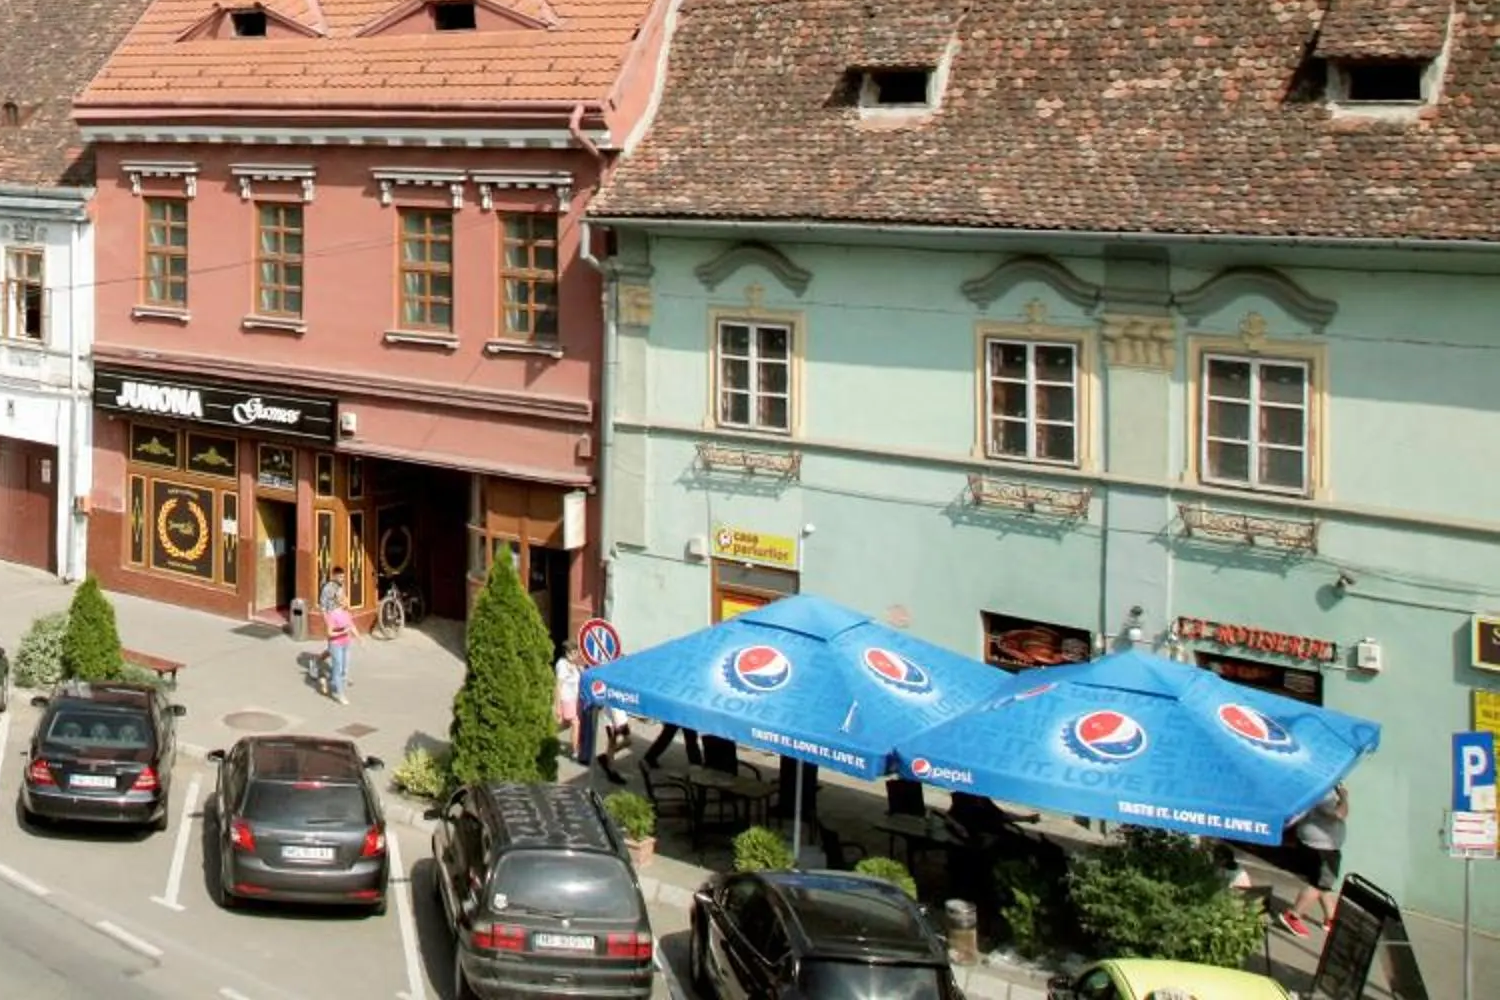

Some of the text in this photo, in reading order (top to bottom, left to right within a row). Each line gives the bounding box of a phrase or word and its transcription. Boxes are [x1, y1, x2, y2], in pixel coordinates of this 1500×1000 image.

[116, 381, 203, 417] JUNONA
[607, 688, 640, 705] pepsi
[751, 727, 779, 742] TASTE
[793, 739, 819, 753] LOVE
[832, 750, 854, 765] LIVE
[929, 766, 974, 786] pepsi
[1461, 745, 1488, 797] P
[1117, 801, 1155, 818] TASTE
[1156, 807, 1172, 819] IT.
[1173, 809, 1206, 825] LOVE
[1224, 817, 1253, 833] LIVE
